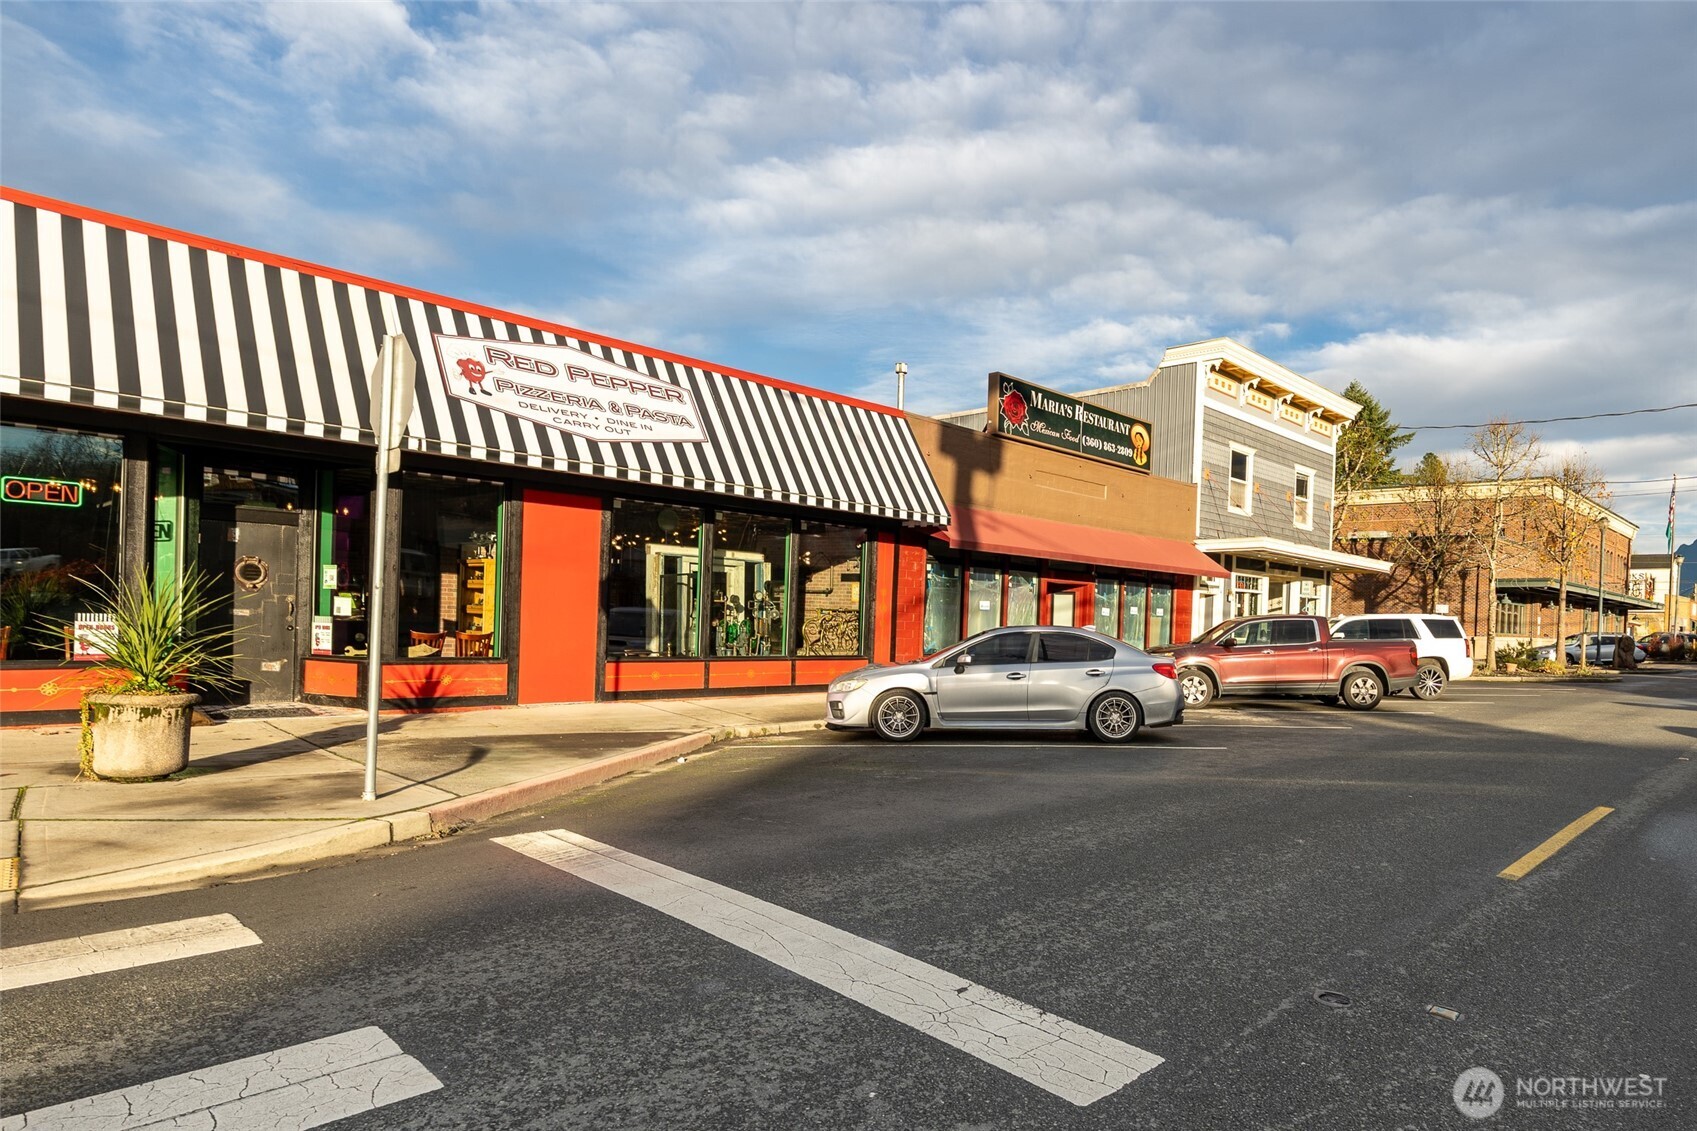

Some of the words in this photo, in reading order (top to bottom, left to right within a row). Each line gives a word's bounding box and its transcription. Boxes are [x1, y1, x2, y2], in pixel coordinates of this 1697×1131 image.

[483, 344, 559, 378] RED
[564, 362, 686, 404] PEPPER
[493, 376, 606, 412] PIZZERIA
[608, 401, 622, 415] &
[624, 403, 695, 428] PASTA
[518, 401, 588, 419] DELIVERY
[606, 417, 637, 430] DINE
[640, 423, 653, 431] IN
[1030, 390, 1073, 418] MARIA'S
[1075, 404, 1131, 436] RESTAURANT
[553, 417, 600, 430] CARRY
[604, 426, 631, 436] OUT
[1030, 420, 1060, 438] Mexican
[1061, 428, 1080, 443] Food
[1082, 434, 1103, 450] (360)
[1103, 442, 1133, 457] 863-2809
[5, 480, 78, 503] OPEN
[153, 523, 171, 539] EN
